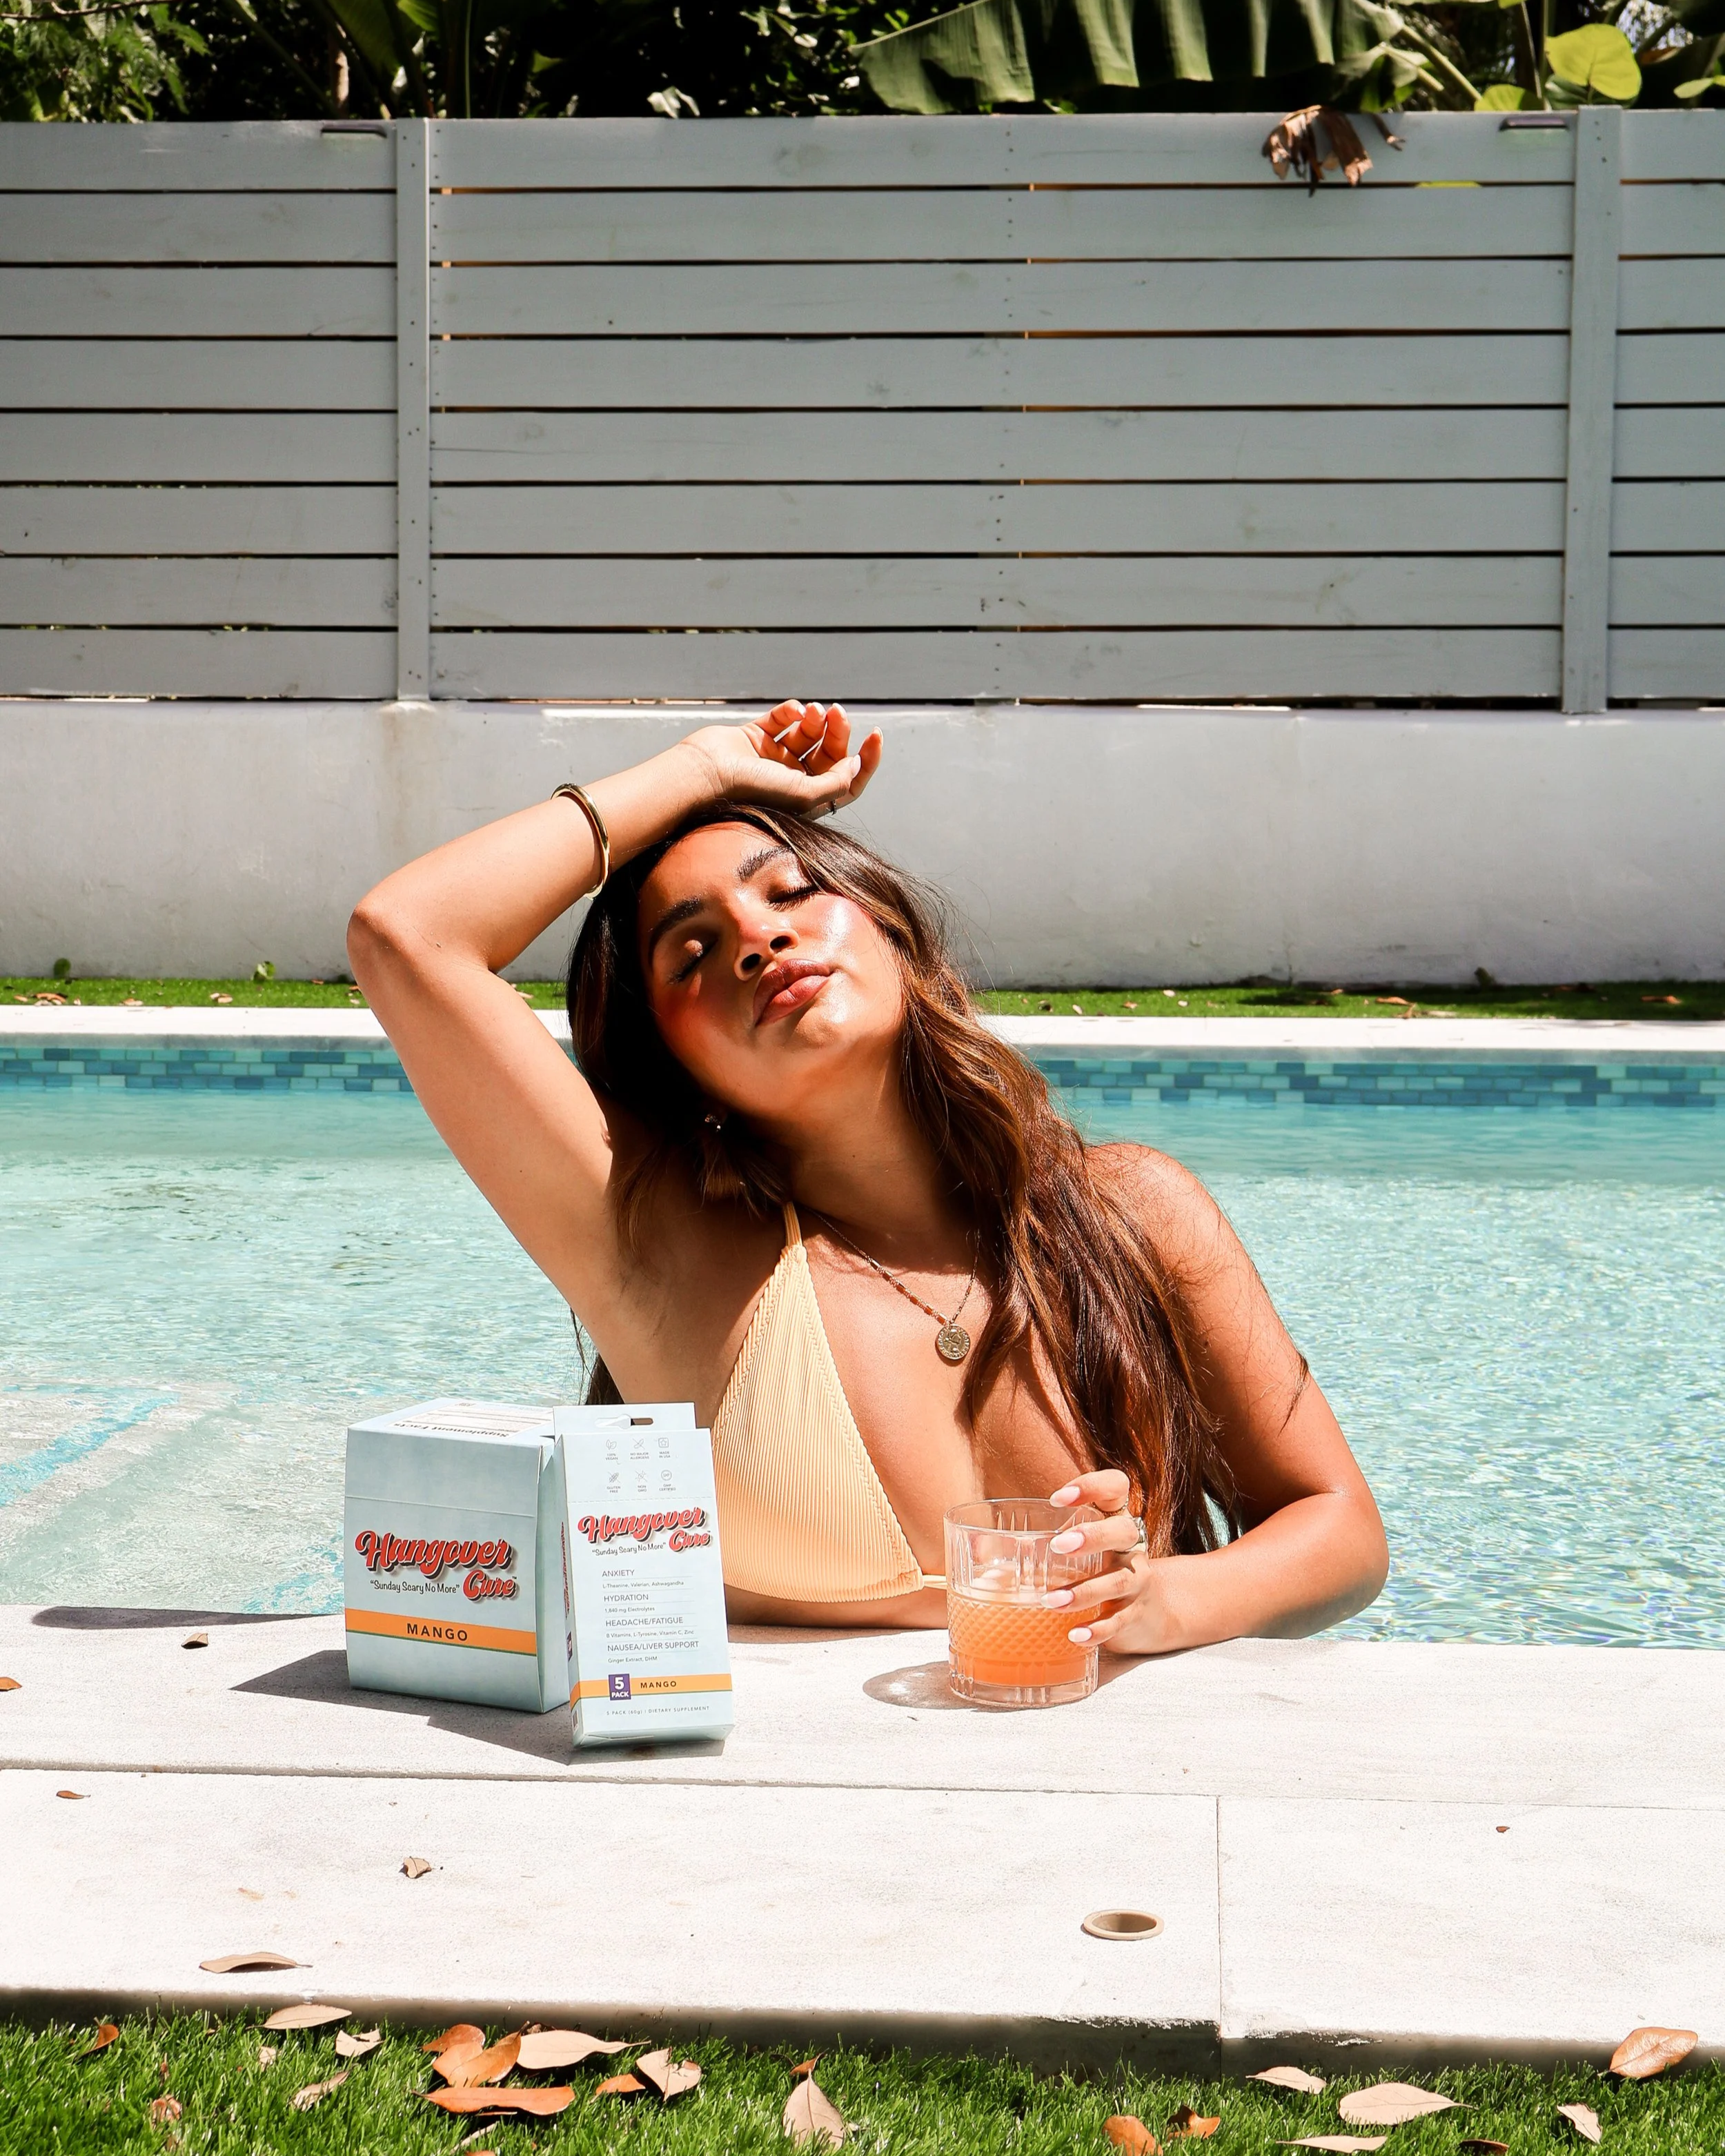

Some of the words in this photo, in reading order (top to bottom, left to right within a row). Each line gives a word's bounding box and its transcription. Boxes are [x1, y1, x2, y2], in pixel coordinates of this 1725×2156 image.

[432, 1427, 509, 1437] Supplement
[578, 1507, 706, 1544] Hangover
[355, 1530, 513, 1580] Hangover
[619, 1545, 637, 1554] Scary
[402, 1581, 424, 1594] Scary
[425, 1585, 435, 1593] No
[604, 1594, 649, 1602] HYDRATION
[605, 1616, 684, 1627] HEADACHE/FATIGUE
[406, 1623, 468, 1641] MANGO
[607, 1642, 663, 1652] NAUSEA/LIVER
[664, 1641, 699, 1649] SUPPORT
[614, 1677, 624, 1690] 5
